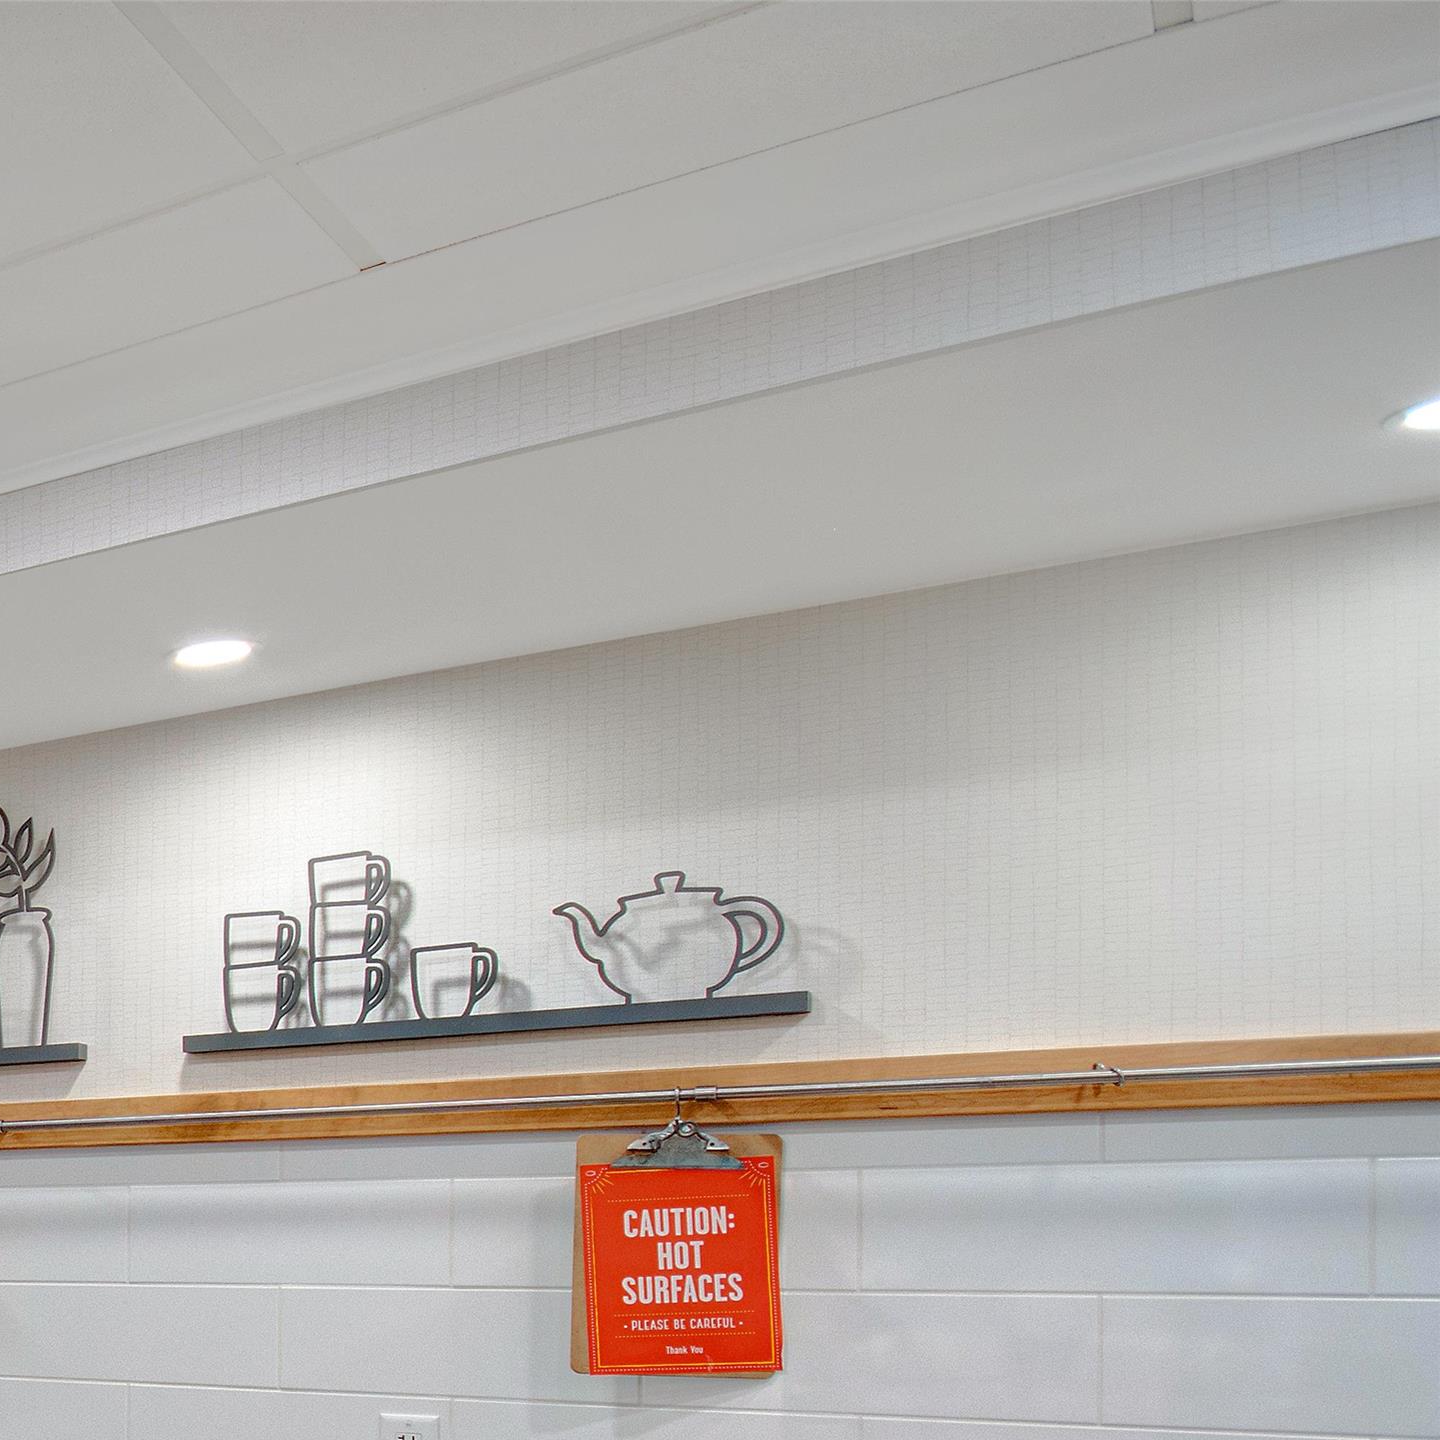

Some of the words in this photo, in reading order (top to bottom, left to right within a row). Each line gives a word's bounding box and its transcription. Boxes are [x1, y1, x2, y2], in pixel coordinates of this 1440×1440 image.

[623, 1206, 736, 1238] CAUTION:
[657, 1240, 704, 1270] HOT
[621, 1273, 744, 1304] SURFACES
[631, 1319, 669, 1331] PLEASE
[673, 1318, 686, 1330] BE
[690, 1317, 736, 1329] CAREFUL
[666, 1346, 688, 1354] Thank
[691, 1345, 704, 1354] You
